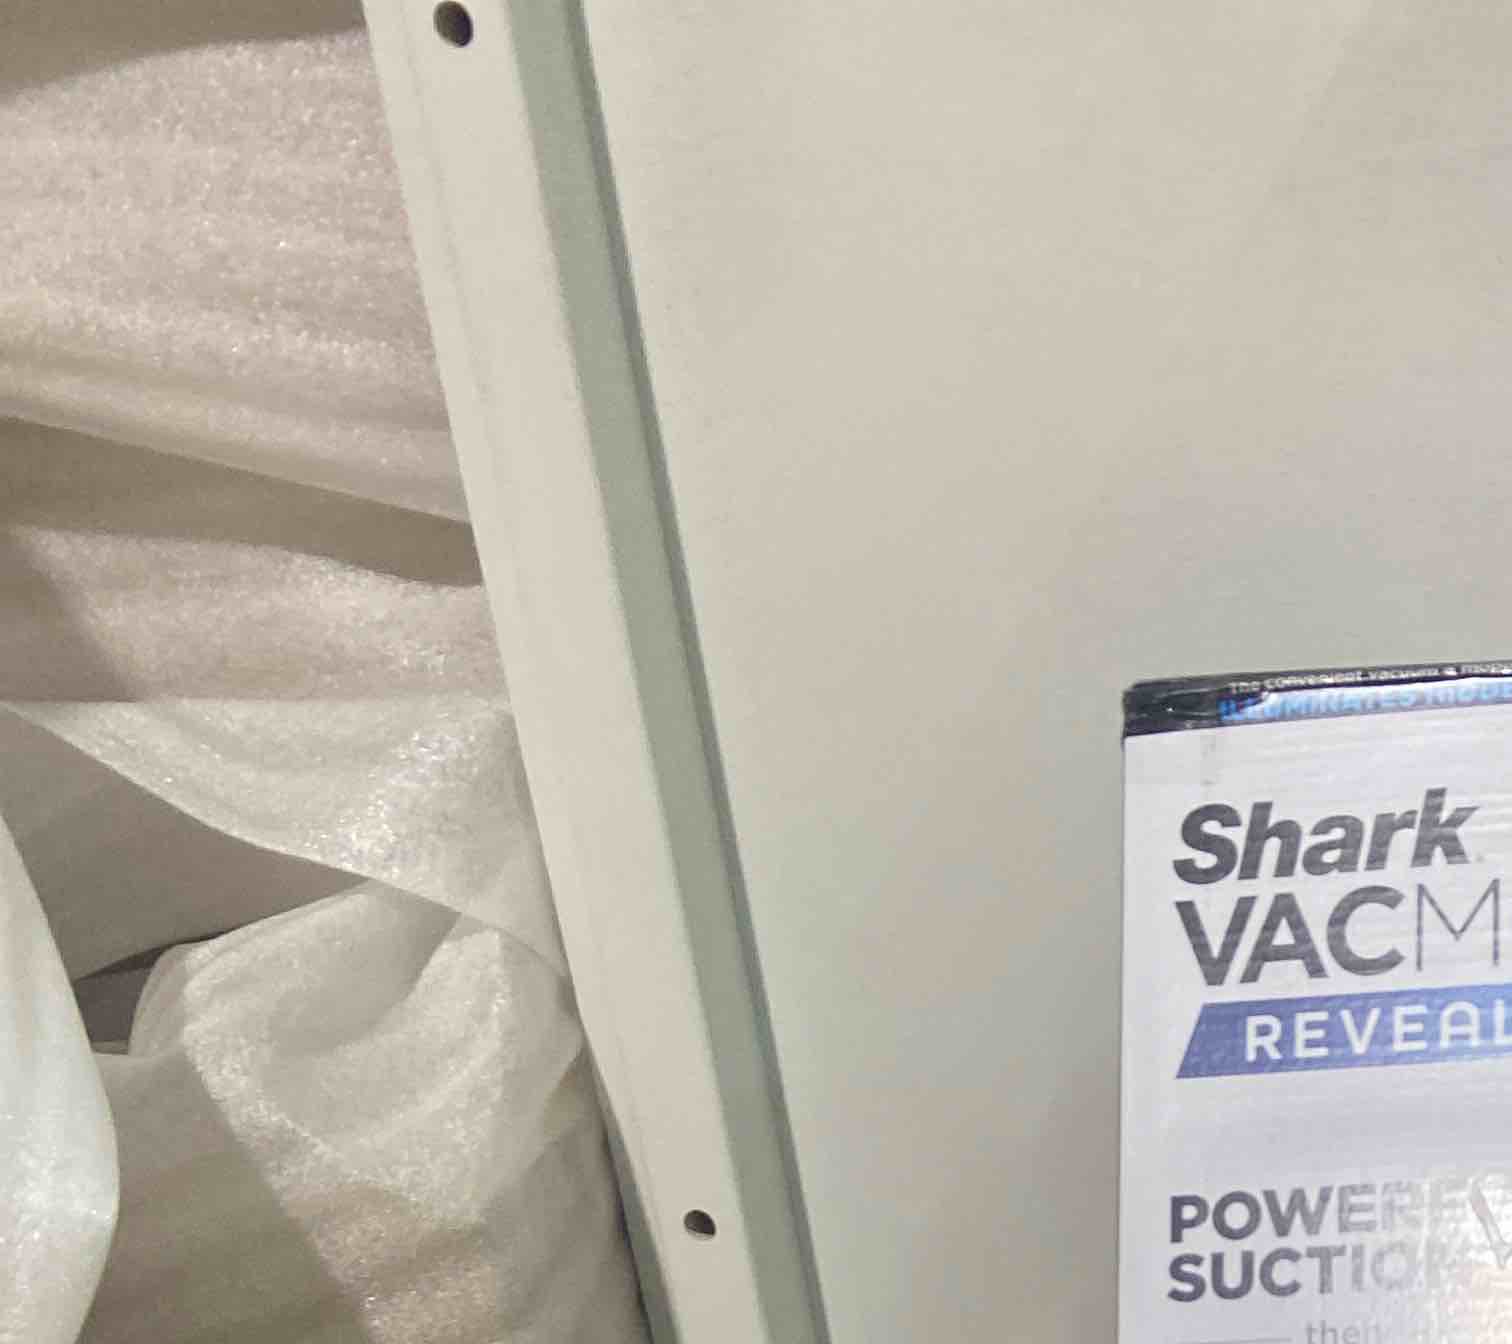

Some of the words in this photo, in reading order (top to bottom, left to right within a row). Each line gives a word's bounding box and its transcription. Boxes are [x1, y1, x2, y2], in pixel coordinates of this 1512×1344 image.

[1173, 787, 1478, 885] Shark
[1170, 1181, 1411, 1243] POWER
[1167, 1244, 1421, 1301] SUCTIO
